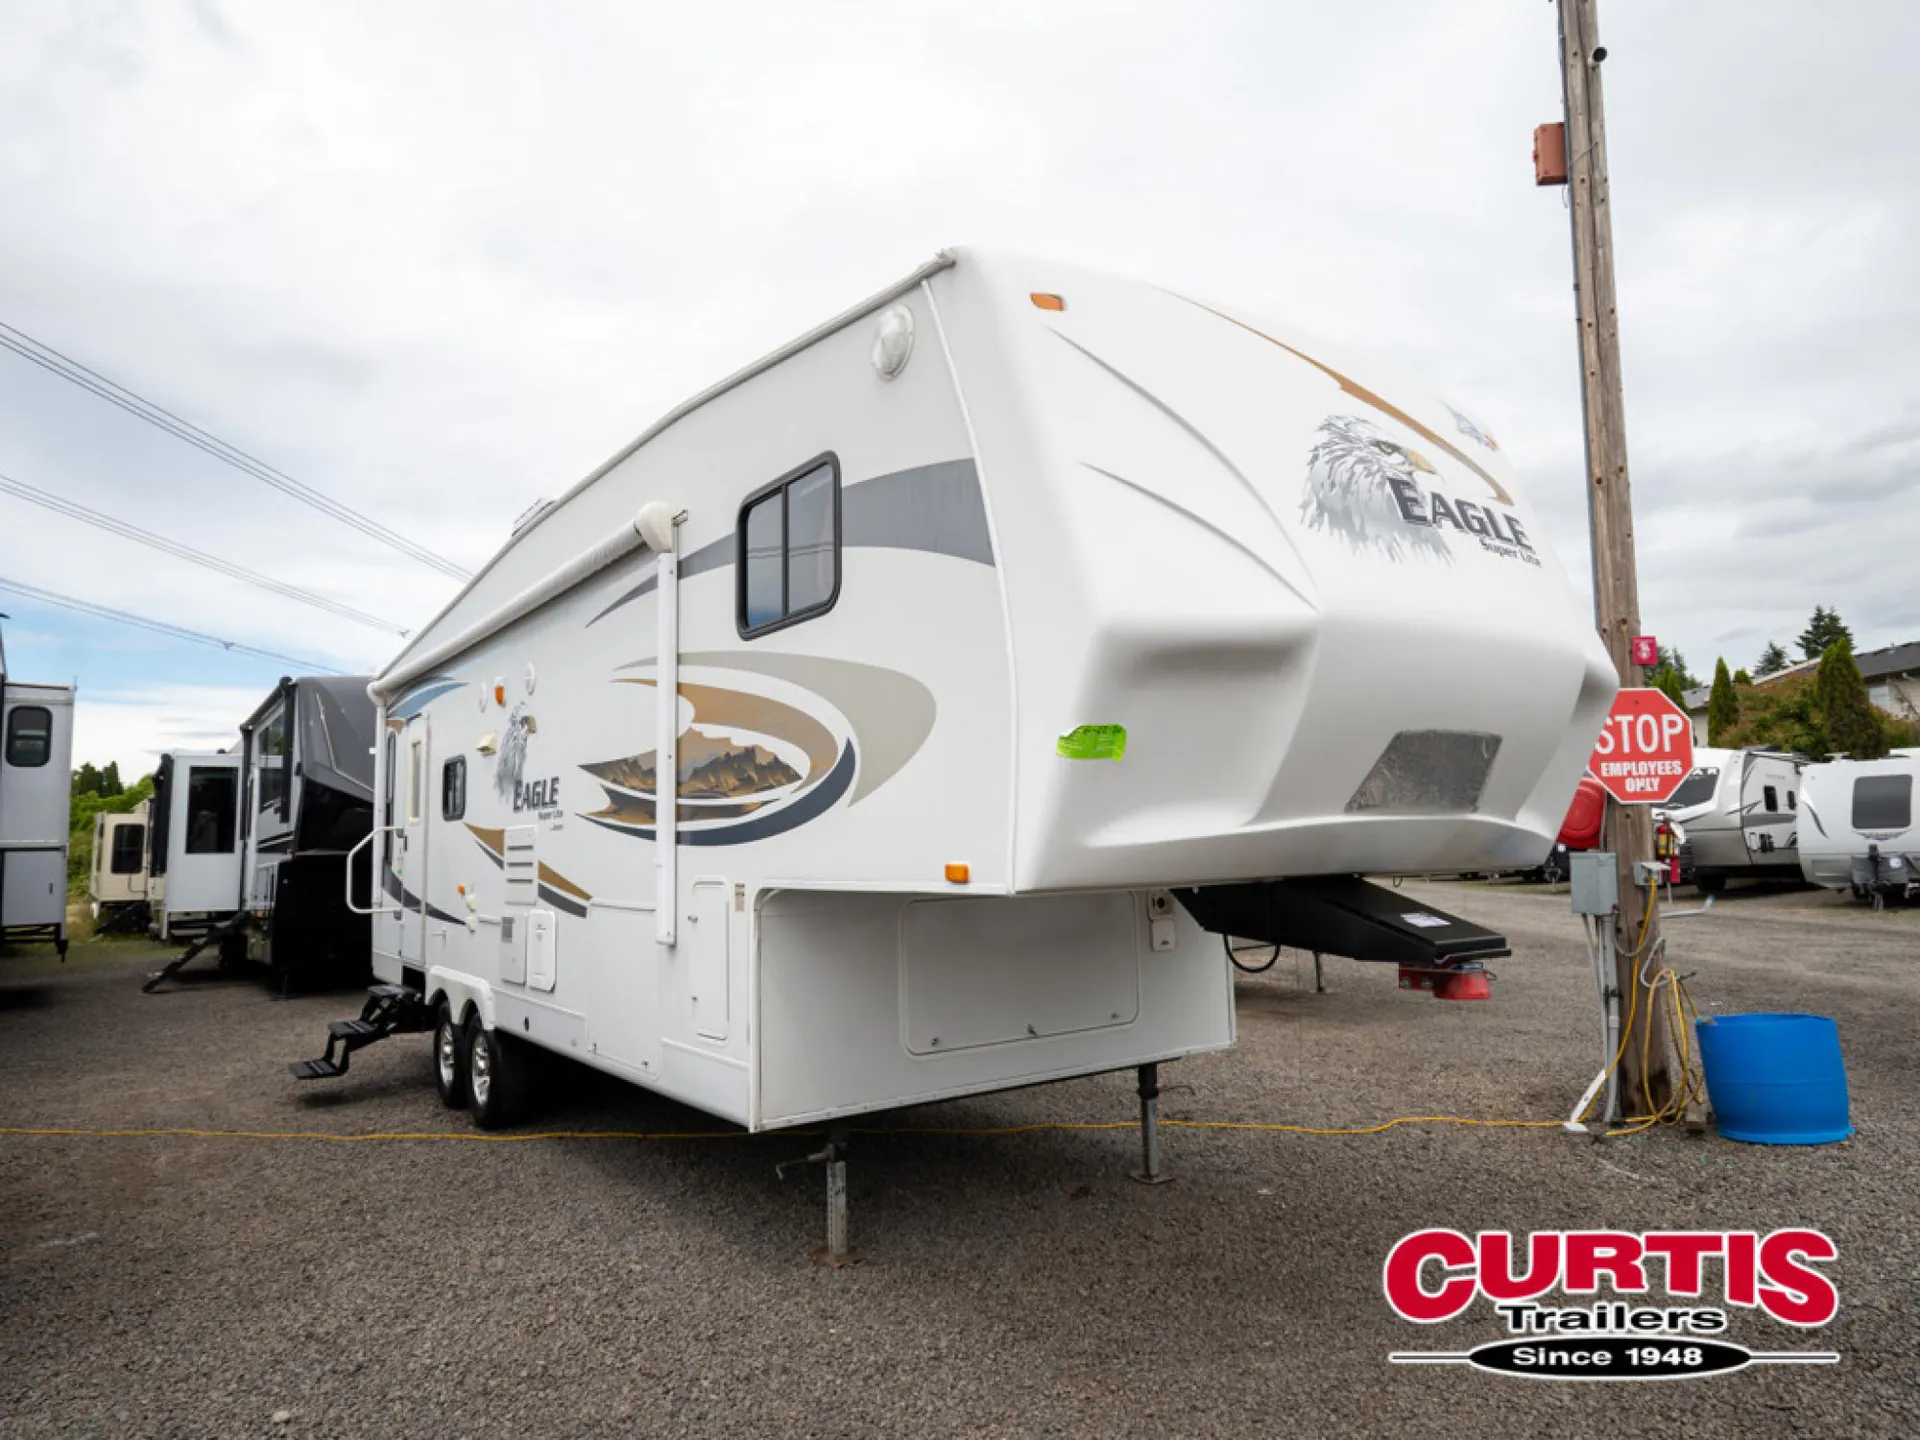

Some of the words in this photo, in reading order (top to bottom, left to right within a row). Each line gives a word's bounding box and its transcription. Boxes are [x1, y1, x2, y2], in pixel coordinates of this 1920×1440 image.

[1387, 478, 1534, 551] EAGLE
[1595, 713, 1684, 755] STOP
[1600, 760, 1683, 777] EMPLOYEES
[1624, 777, 1661, 793] ONLY
[513, 776, 560, 813] EAGLE
